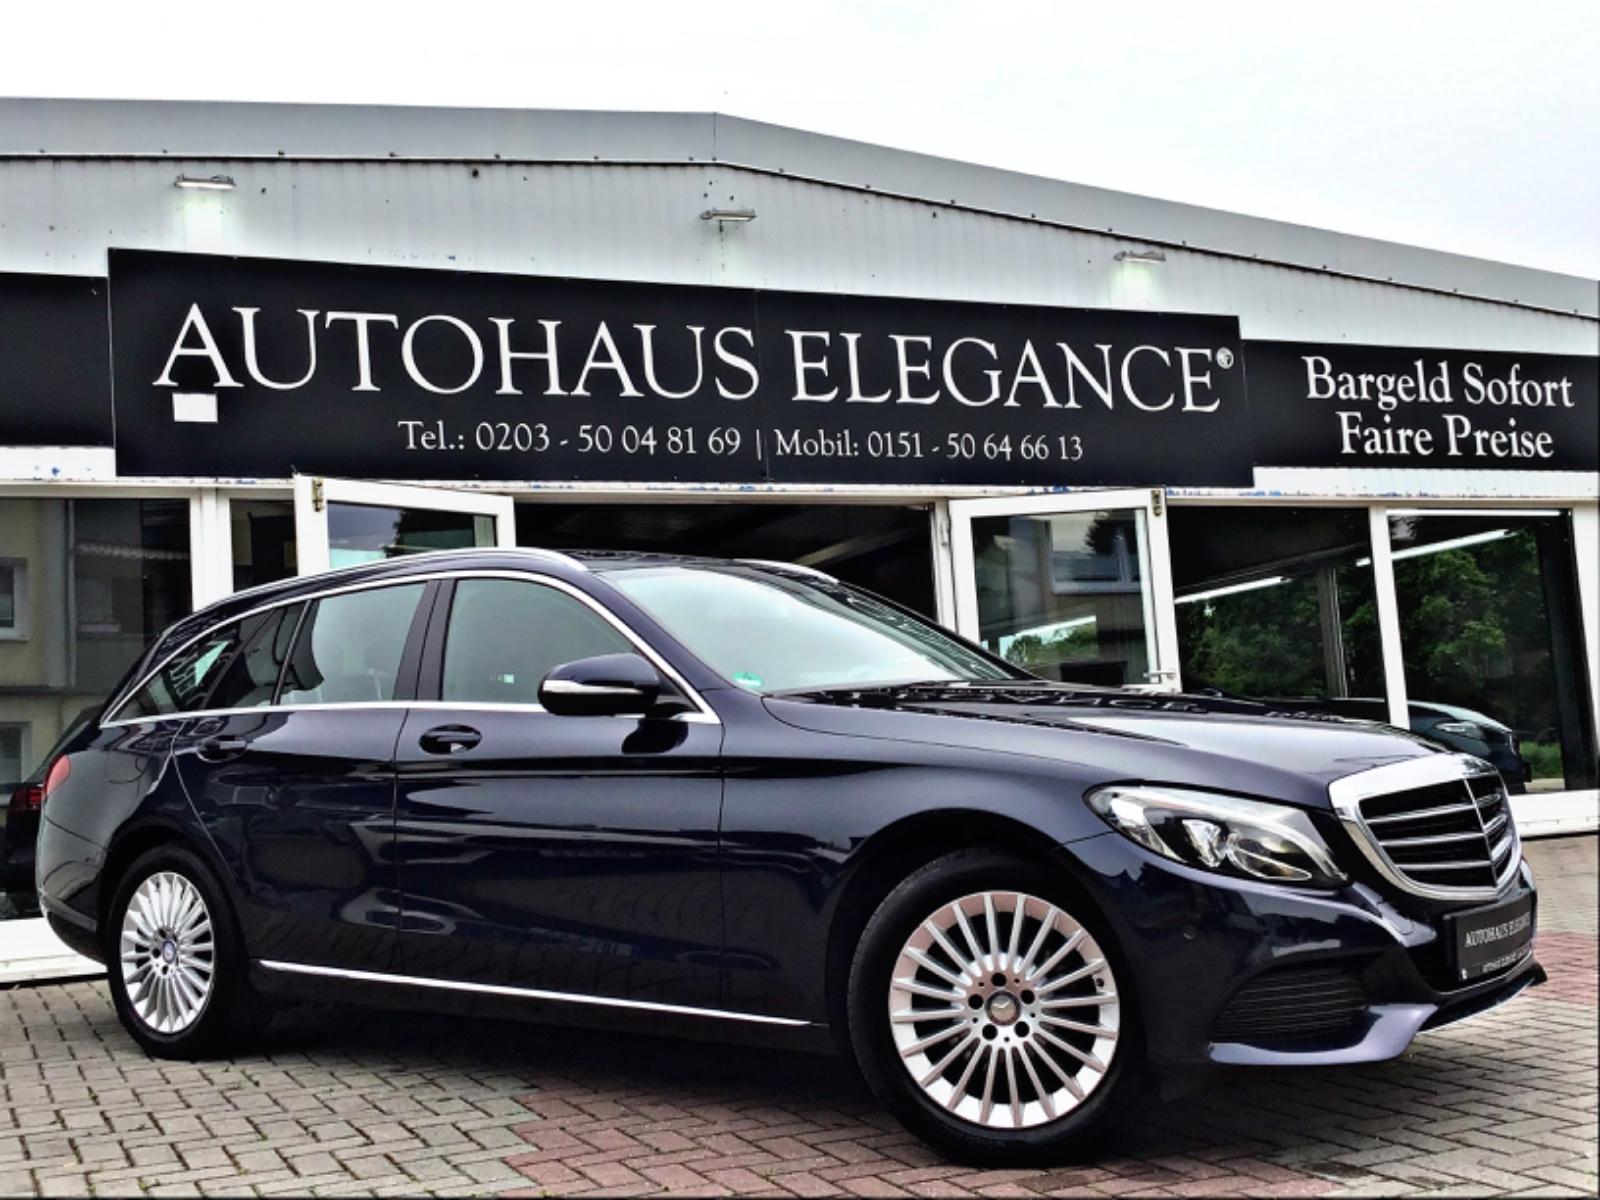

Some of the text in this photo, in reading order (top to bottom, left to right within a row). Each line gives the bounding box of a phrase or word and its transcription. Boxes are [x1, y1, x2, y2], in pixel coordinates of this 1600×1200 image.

[152, 302, 760, 401] AUTOHAUS
[1301, 355, 1575, 411] Bargeld Sofort
[397, 419, 465, 450] Tel.:
[475, 421, 550, 452] 0203
[578, 424, 613, 453] 50
[621, 425, 658, 455] 04
[667, 426, 697, 454] 81
[707, 427, 741, 455] 69
[773, 428, 859, 456] Mobil:
[867, 430, 924, 458] 0151
[947, 432, 976, 459] 50
[983, 433, 1013, 461] 64
[1020, 434, 1050, 460] 66
[1058, 435, 1083, 461] 13
[1335, 411, 1554, 458] Faire Preise
